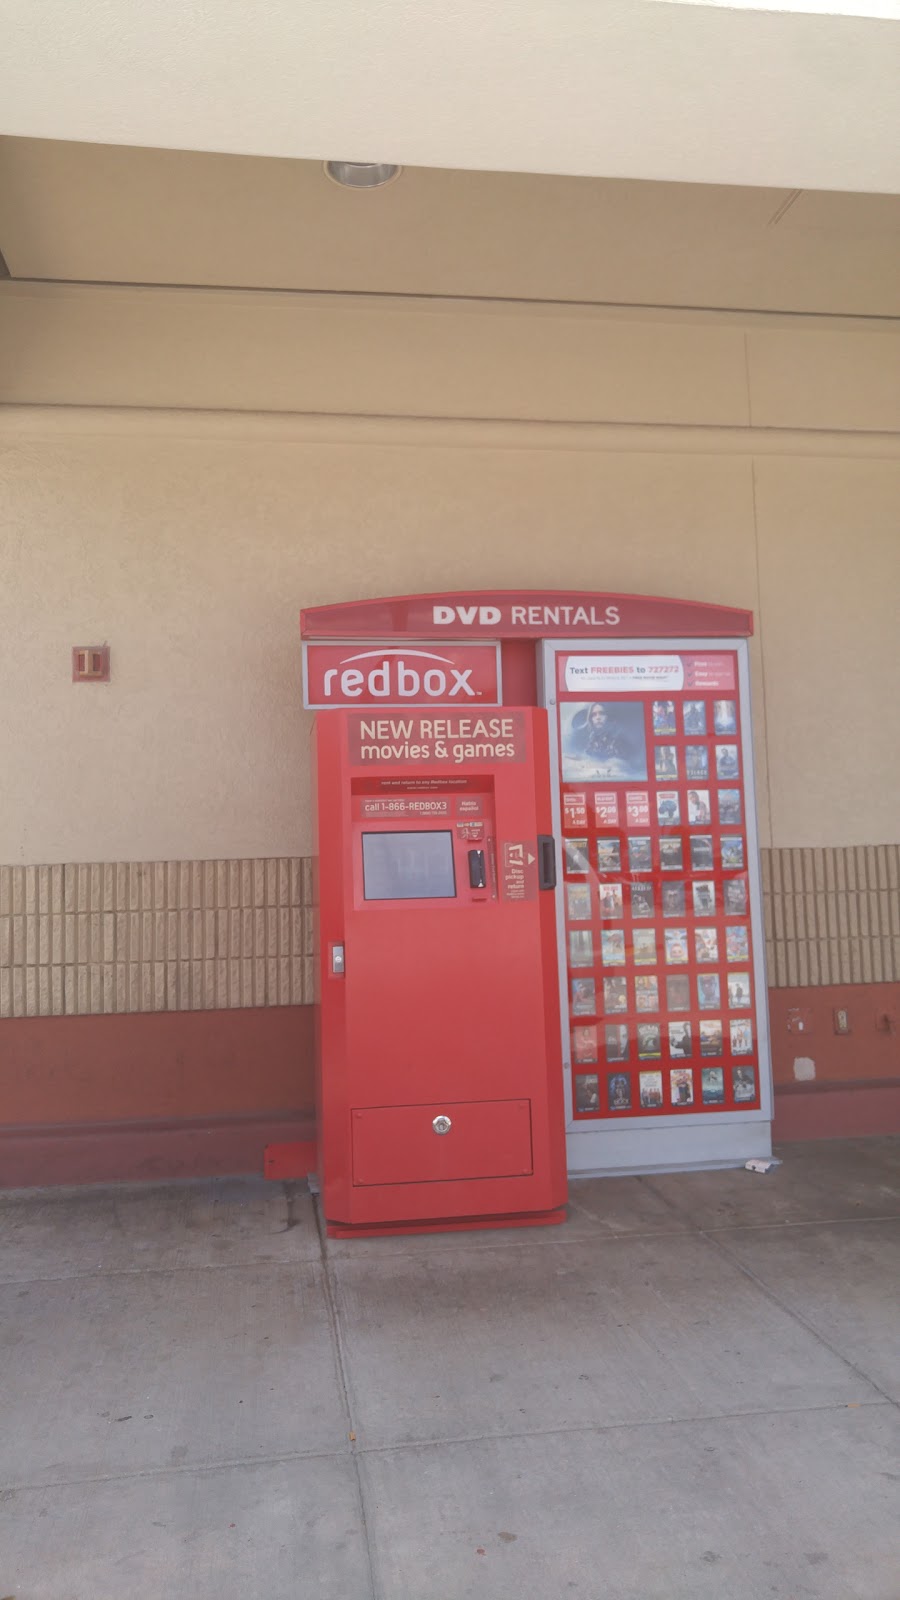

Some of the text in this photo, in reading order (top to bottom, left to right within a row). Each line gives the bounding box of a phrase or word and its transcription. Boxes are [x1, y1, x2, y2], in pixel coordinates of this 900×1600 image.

[433, 605, 620, 625] DVD RENTALS
[570, 665, 679, 675] Text FREEBIES to 727272
[323, 660, 476, 697] redbox
[360, 718, 515, 740] NEW RELEASE
[361, 740, 515, 763] movies & games
[365, 801, 447, 811] call 1-866-REDBOX3
[596, 806, 616, 818] $2.00
[628, 805, 648, 817] $3.00
